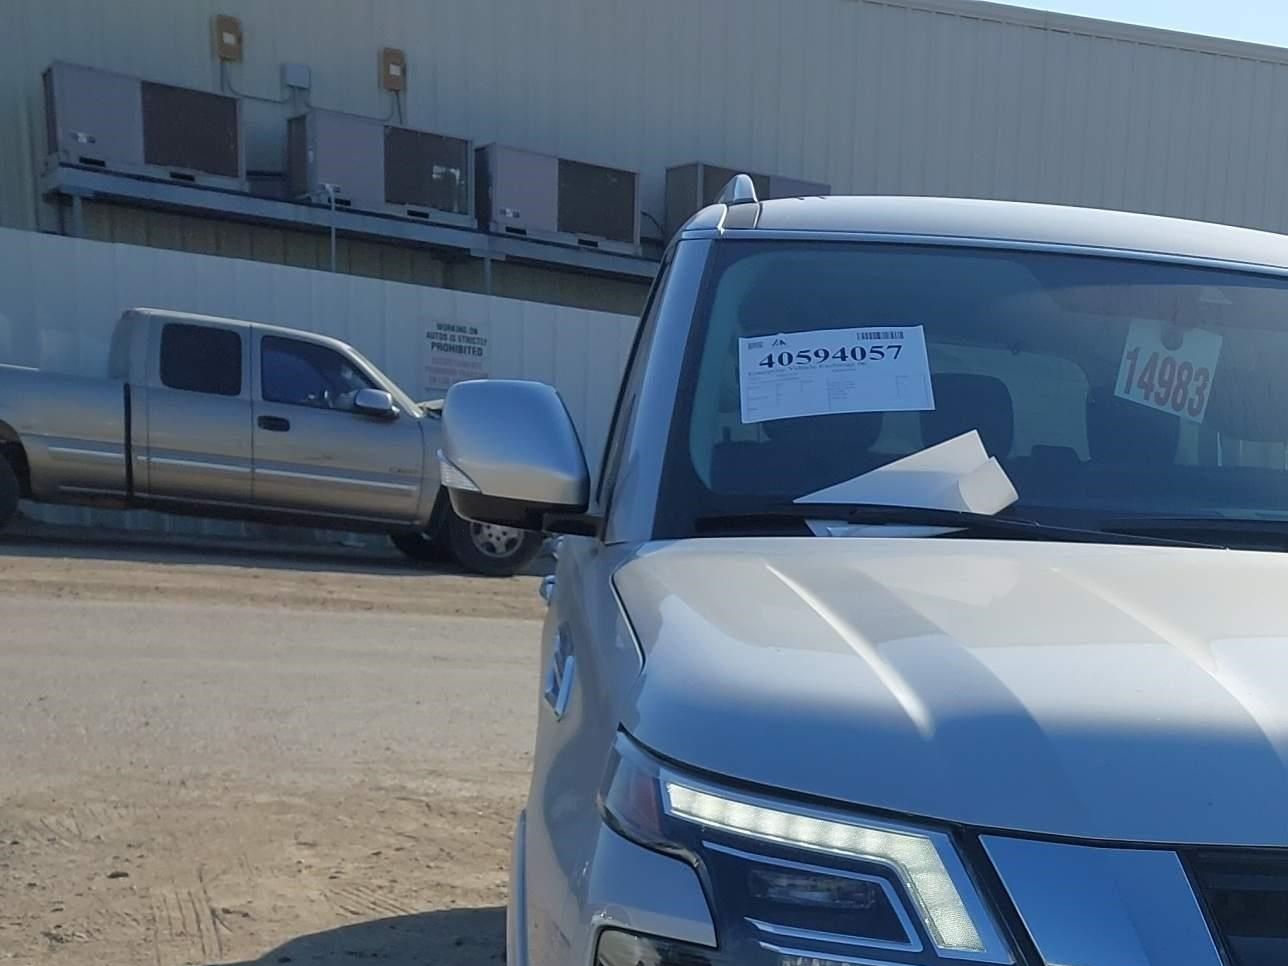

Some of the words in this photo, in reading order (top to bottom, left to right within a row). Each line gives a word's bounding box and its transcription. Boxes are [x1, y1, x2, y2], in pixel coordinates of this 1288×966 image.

[431, 341, 484, 357] PROHIBITED
[759, 344, 903, 369] 40594057
[1123, 346, 1210, 417] 14983
